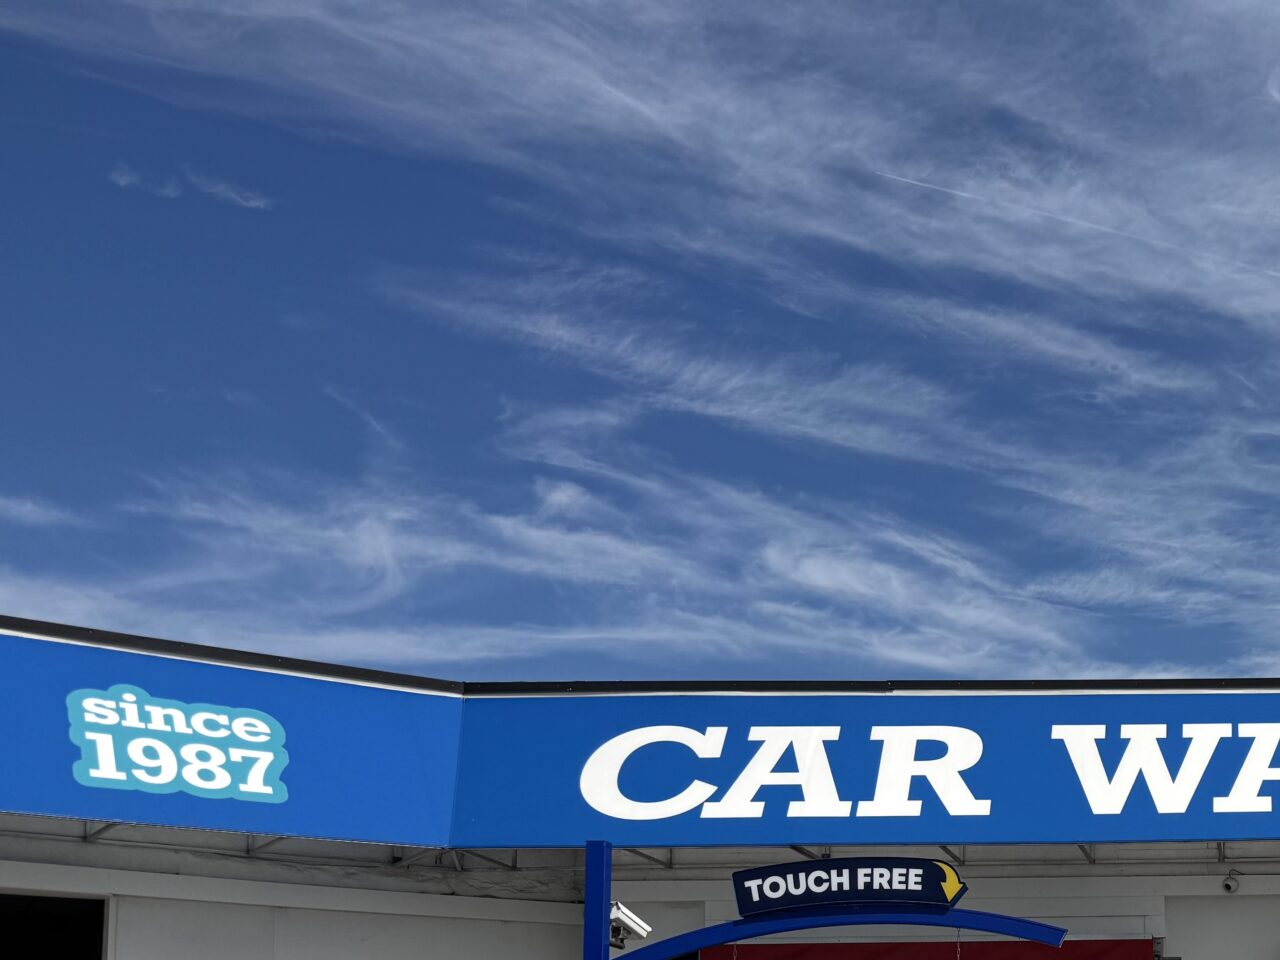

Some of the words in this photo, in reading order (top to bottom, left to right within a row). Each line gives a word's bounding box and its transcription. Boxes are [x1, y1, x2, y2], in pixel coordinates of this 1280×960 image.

[82, 693, 271, 742] since
[85, 731, 275, 794] 1987
[580, 725, 992, 820] CAR
[744, 869, 850, 901] TOUCH
[857, 868, 923, 890] FREE
